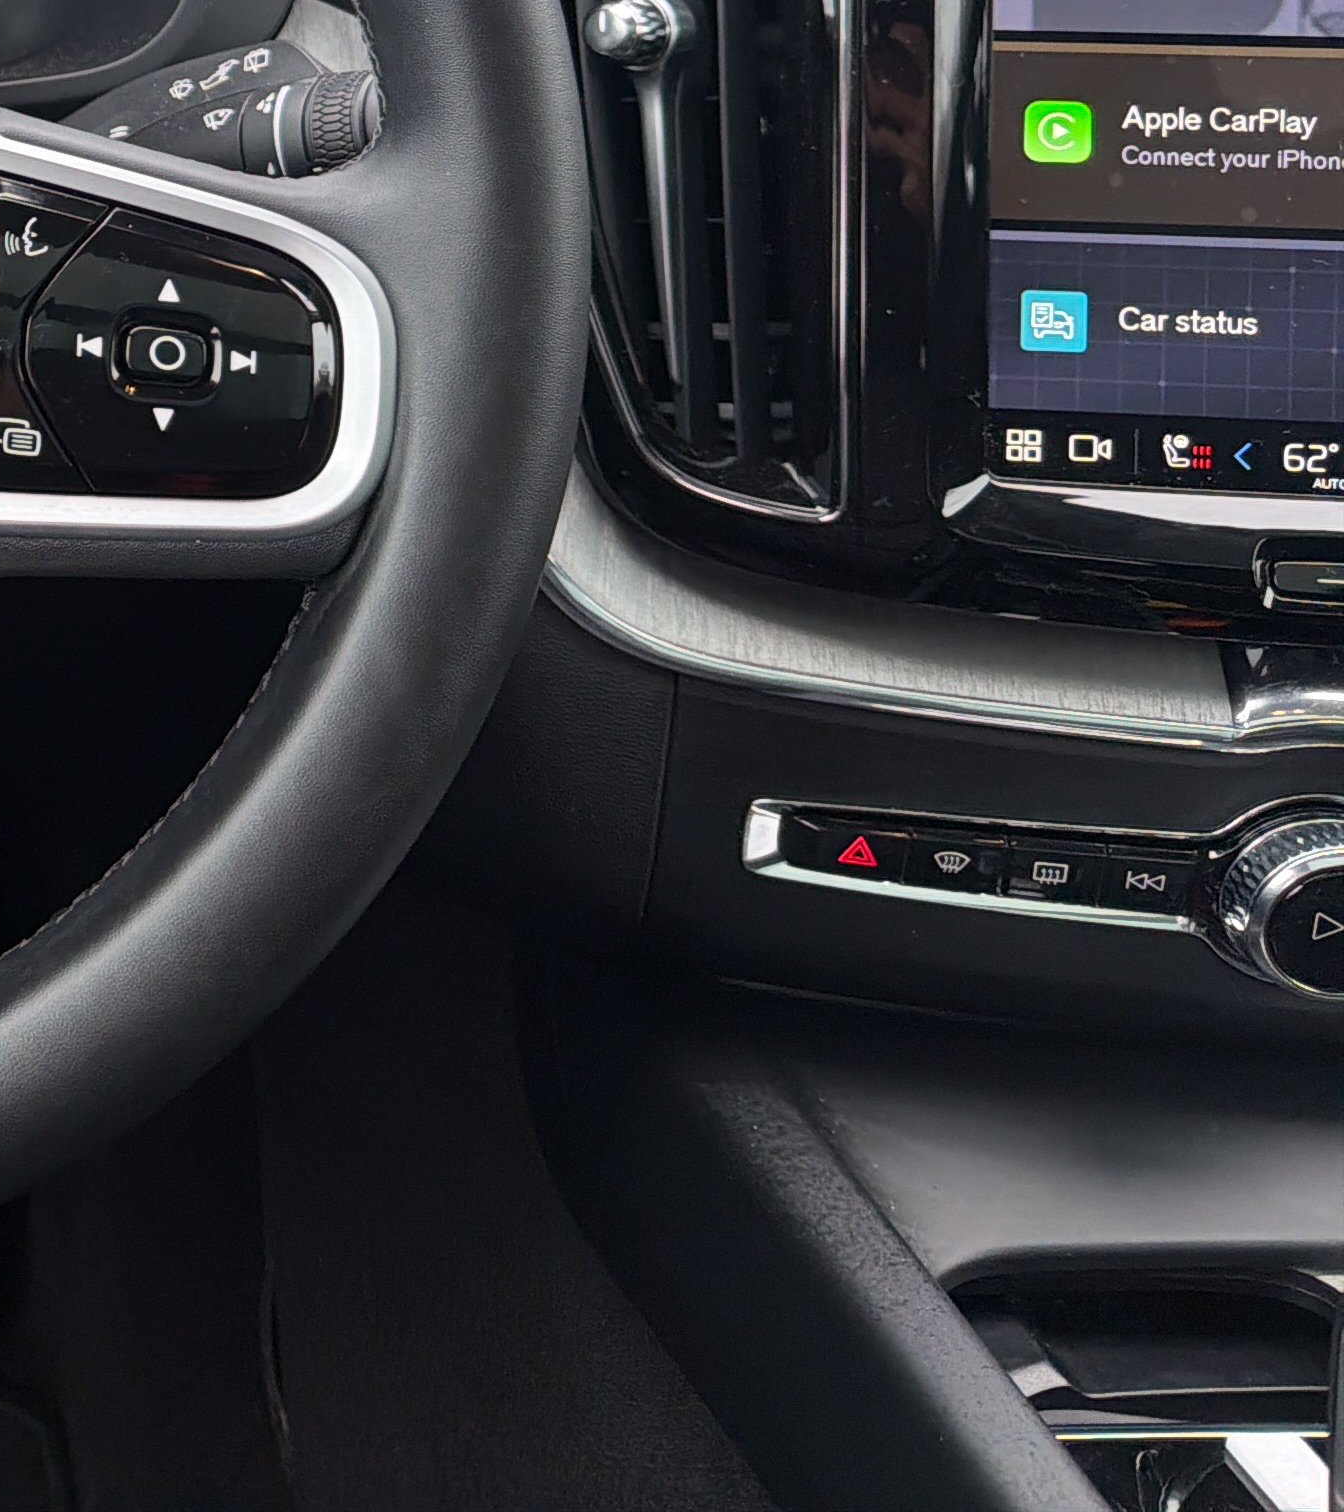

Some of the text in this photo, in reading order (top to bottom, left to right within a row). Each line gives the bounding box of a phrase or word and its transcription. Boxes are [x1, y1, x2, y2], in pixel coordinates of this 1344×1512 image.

[1121, 104, 1318, 141] Apple CarPlay
[1121, 144, 1344, 174] Connect your iPhon
[1118, 307, 1259, 336] Car status
